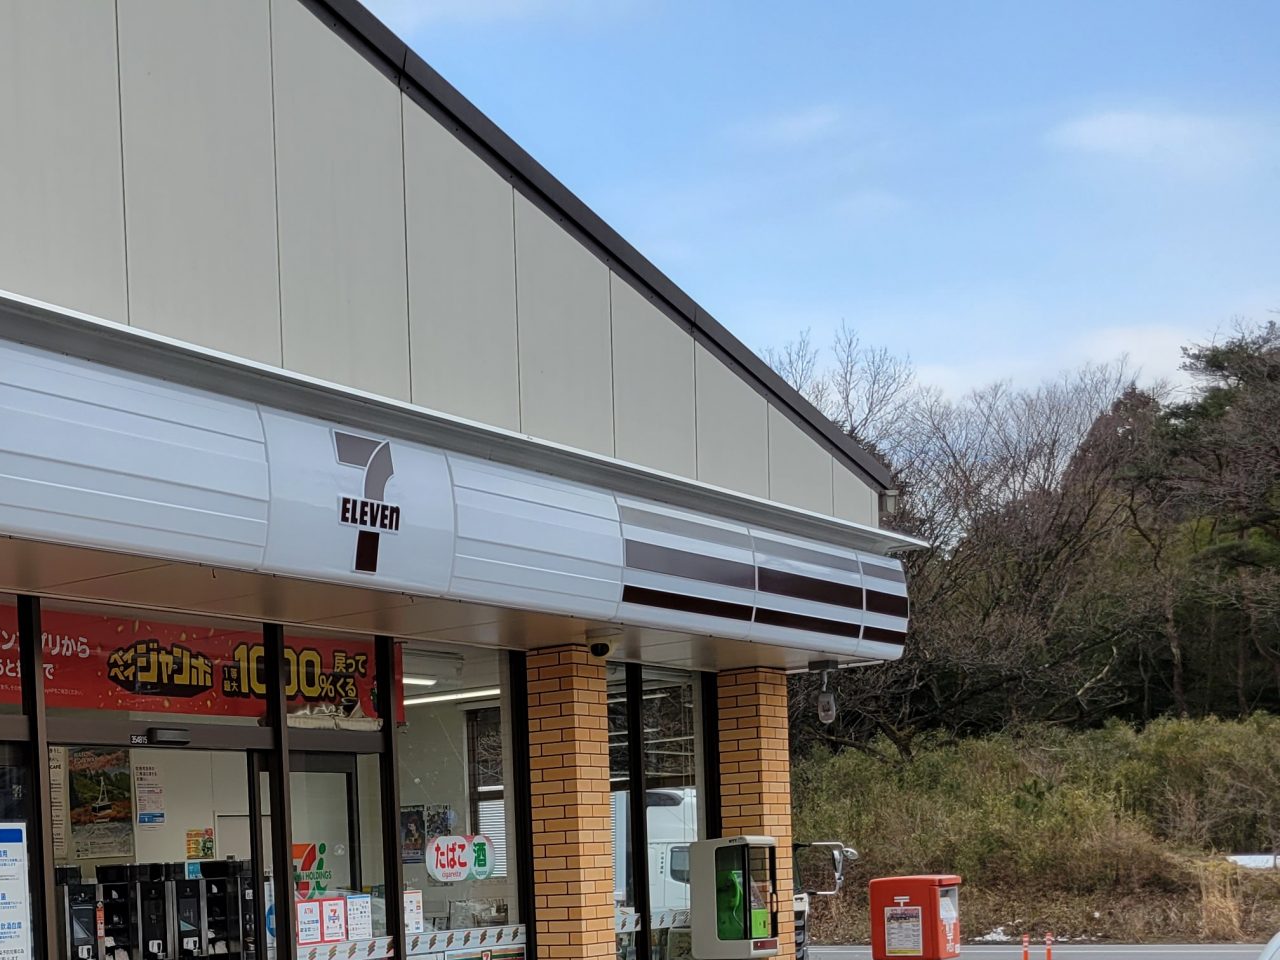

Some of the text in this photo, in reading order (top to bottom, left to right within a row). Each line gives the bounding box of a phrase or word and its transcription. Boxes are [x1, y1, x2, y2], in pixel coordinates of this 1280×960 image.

[434, 841, 487, 869] たばこ 酒
